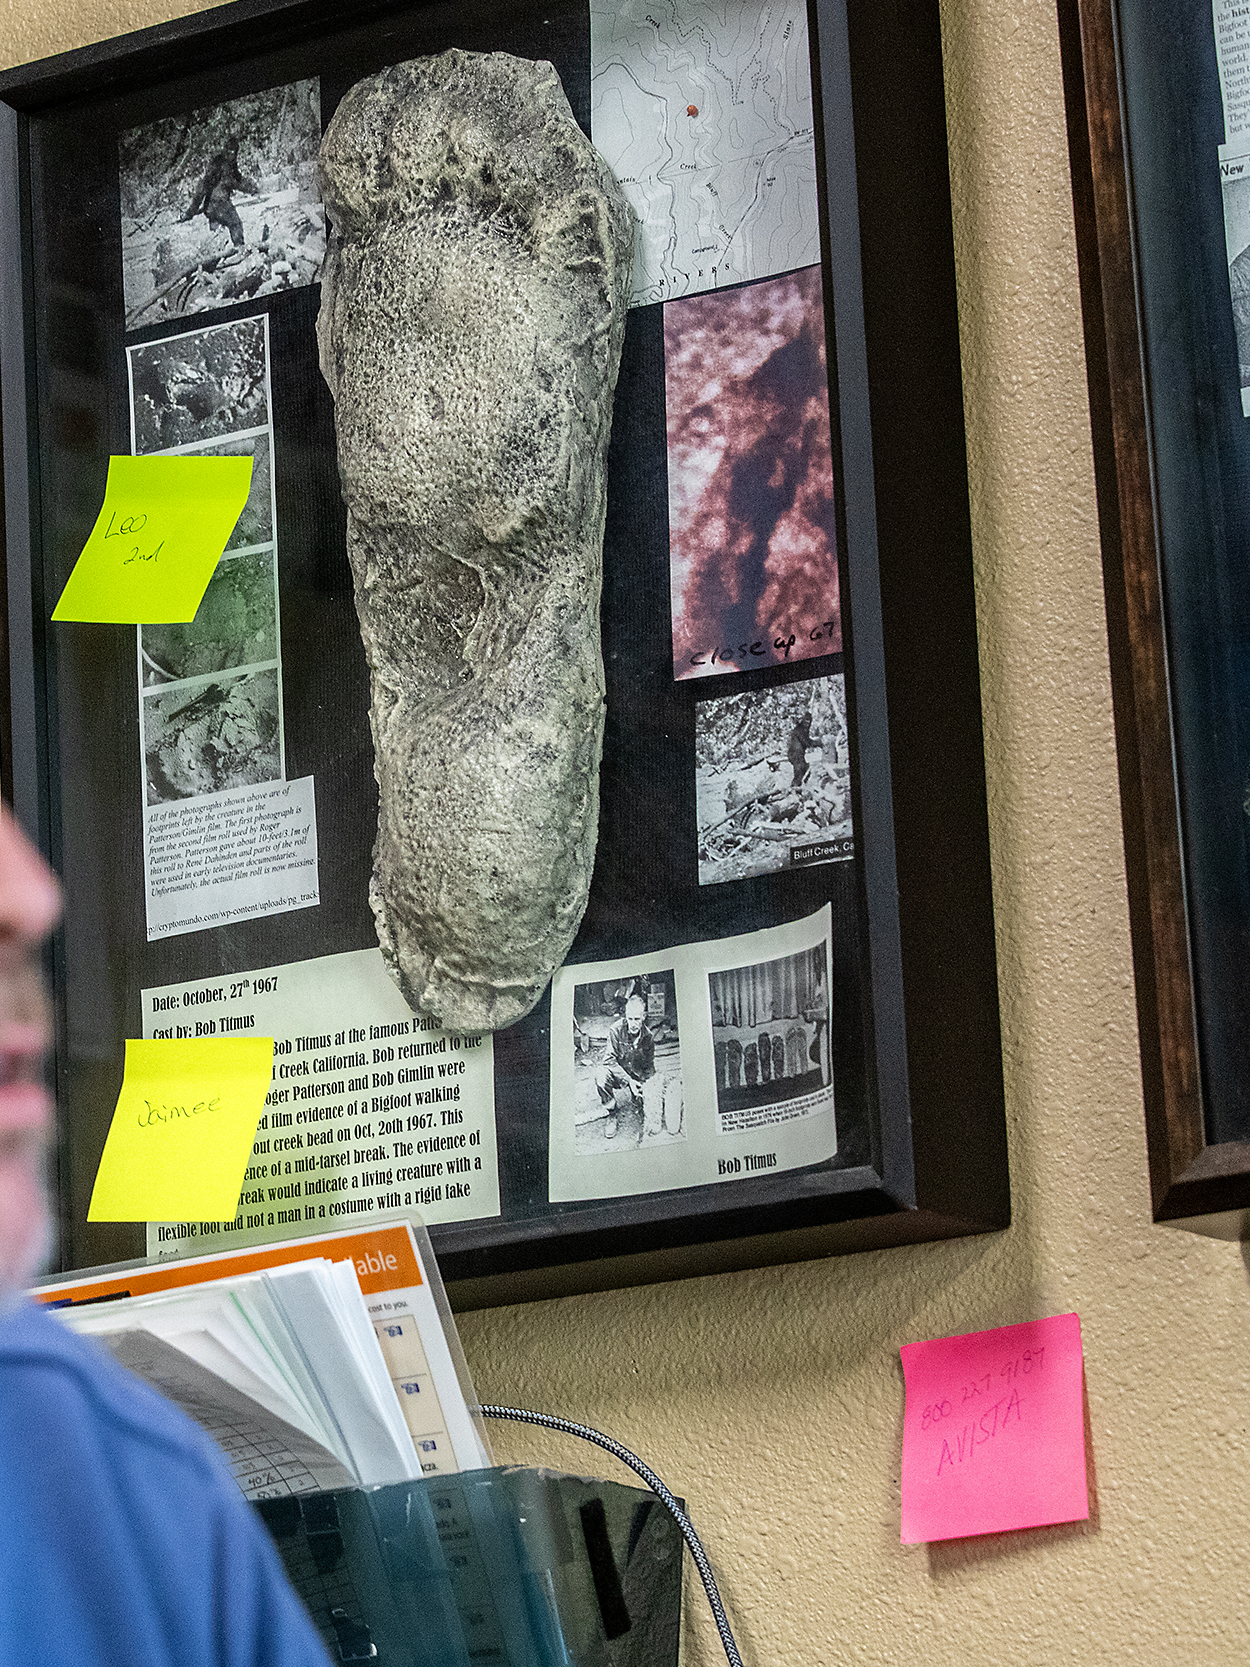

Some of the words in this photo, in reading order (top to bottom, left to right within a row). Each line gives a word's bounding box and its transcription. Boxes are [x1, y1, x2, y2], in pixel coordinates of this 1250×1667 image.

[1219, 20, 1248, 33] Bigfoot
[1220, 35, 1234, 44] can
[1236, 31, 1245, 39] be
[1223, 68, 1245, 79] them
[1230, 124, 1243, 134] but
[1221, 163, 1244, 176] New
[123, 540, 165, 565] 2nd
[773, 634, 796, 657] up
[810, 621, 835, 641] 67
[147, 813, 158, 822] All
[159, 811, 167, 822] of
[168, 809, 178, 818] the
[179, 800, 221, 818] photographs
[223, 795, 245, 807] shown
[246, 791, 267, 802] above
[281, 786, 290, 797] of
[147, 818, 180, 834] footprints
[181, 816, 192, 827] left
[194, 814, 203, 825] by
[204, 811, 215, 820] the
[216, 805, 244, 818] creature
[246, 803, 253, 812] in
[254, 801, 265, 810] the
[225, 818, 236, 827] The
[238, 815, 252, 827] first
[253, 806, 293, 824] photograph
[295, 805, 301, 813] is
[148, 843, 164, 856] from
[166, 841, 176, 850] the
[177, 836, 202, 848] second
[201, 833, 216, 845] film
[218, 830, 229, 840] roll
[231, 826, 247, 837] used
[249, 824, 257, 835] by
[259, 820, 280, 833] Roger
[184, 843, 217, 857] Patterson
[219, 842, 234, 852] gave
[236, 835, 256, 846] about
[302, 824, 310, 835] of
[793, 848, 813, 860] Bluff
[149, 865, 161, 875] this
[163, 862, 175, 872] roll
[177, 861, 183, 869] to
[238, 847, 251, 857] and
[253, 843, 270, 856] parts
[272, 841, 280, 852] of
[281, 838, 292, 848] the
[294, 835, 306, 845] roll
[199, 877, 210, 887] the
[212, 873, 232, 884] actual
[234, 869, 247, 882] film
[249, 867, 261, 876] roll
[263, 865, 269, 873] is
[271, 864, 285, 872] now
[152, 993, 179, 1012] Date:
[183, 984, 227, 1009] October,
[252, 975, 278, 994] 1967
[152, 1026, 172, 1043] Cast
[176, 1023, 191, 1042] by:
[195, 1018, 215, 1036] Bob
[218, 1012, 255, 1032] Titmus
[295, 1032, 331, 1052] Titmus
[334, 1029, 344, 1046] at
[347, 1026, 365, 1043] the
[369, 1019, 409, 1040] famous
[279, 1059, 309, 1079] Creek
[313, 1050, 369, 1073] California.
[372, 1045, 394, 1064] Bob
[397, 1037, 446, 1060] returned
[449, 1035, 461, 1051] to
[292, 1078, 344, 1101] Patterson
[348, 1074, 368, 1092] and
[371, 1070, 393, 1088] Bob
[397, 1063, 433, 1084] Gimlin
[438, 1061, 465, 1078] were
[138, 1097, 222, 1127] Jaimee
[271, 1110, 292, 1128] film
[295, 1102, 343, 1124] evidence
[346, 1100, 358, 1116] of
[361, 1101, 368, 1114] a
[371, 1091, 412, 1115] Bigfoot
[414, 1083, 460, 1108] walking
[252, 1137, 270, 1155] out
[273, 1132, 303, 1151] creek
[306, 1127, 333, 1146] bead
[337, 1128, 350, 1142] on
[353, 1121, 374, 1142] Oct,
[405, 1111, 436, 1131] 1967.
[440, 1107, 463, 1126] This
[270, 1160, 281, 1176] of
[284, 1161, 291, 1174] a
[294, 1149, 350, 1172] mid-tarsel
[353, 1143, 389, 1163] break.
[393, 1139, 413, 1157] The
[416, 1131, 465, 1154] evidence
[468, 1129, 481, 1146] of
[717, 1157, 741, 1175] Bob
[744, 1153, 777, 1171] Titmus
[268, 1181, 301, 1201] would
[304, 1174, 348, 1195] indicate
[351, 1175, 358, 1188] a
[361, 1167, 393, 1189] living
[395, 1160, 443, 1182] creature
[446, 1156, 471, 1174] with
[474, 1157, 481, 1170] a
[157, 1221, 196, 1241] flexible
[246, 1211, 264, 1228] not
[267, 1212, 274, 1225] a
[277, 1208, 301, 1224] man
[304, 1203, 315, 1220] in
[318, 1205, 325, 1218] a
[328, 1195, 373, 1216] costume
[376, 1191, 401, 1209] with
[404, 1192, 411, 1205] a
[415, 1185, 441, 1206] rigid
[444, 1180, 471, 1199] fake
[355, 1249, 398, 1276] able
[921, 1400, 952, 1431] 800
[937, 1388, 1024, 1476] AVISTA
